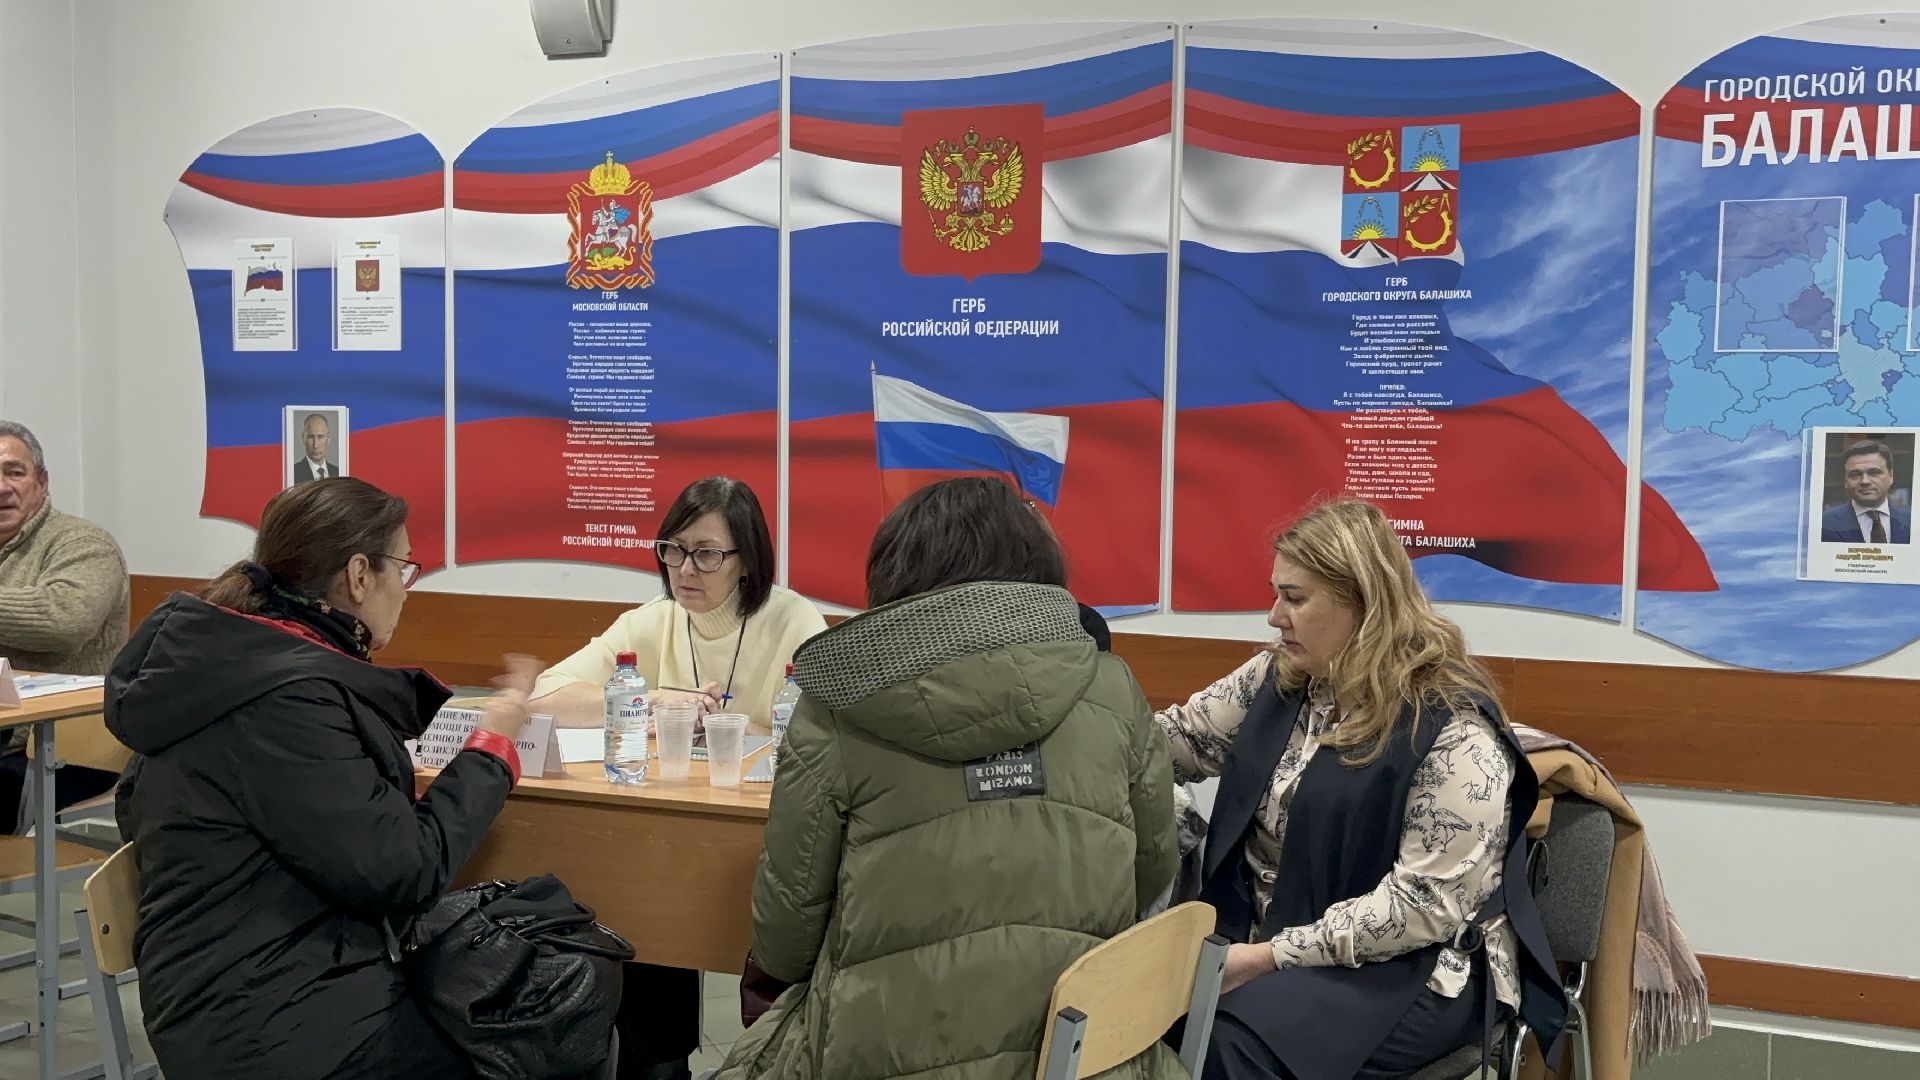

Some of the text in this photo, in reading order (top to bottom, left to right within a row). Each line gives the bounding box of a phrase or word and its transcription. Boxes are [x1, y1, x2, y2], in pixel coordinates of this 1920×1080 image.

[1704, 66, 1920, 103] ГОРОДСКОЙ ОК
[1386, 277, 1408, 286] ГЕРБ
[602, 292, 618, 300] ГЕРБ
[1322, 290, 1472, 302] ГОРОДСКОГО ОКРУГА БАЛАШИХА
[572, 302, 649, 311] МОСКОВСКОЙ ОБЛАСТИ
[952, 298, 986, 314] ГЕРБ
[882, 318, 1059, 338] РОССИЙСКОЙ ФЕДЕРАЦИИ
[585, 524, 637, 534] ТЕКСТ ГИМНА
[562, 536, 655, 549] РОССИЙСКОЙ ФЕДЕРАЦИ
[1416, 536, 1476, 548] БАЛАШИХА
[976, 763, 1032, 777] LONDON
